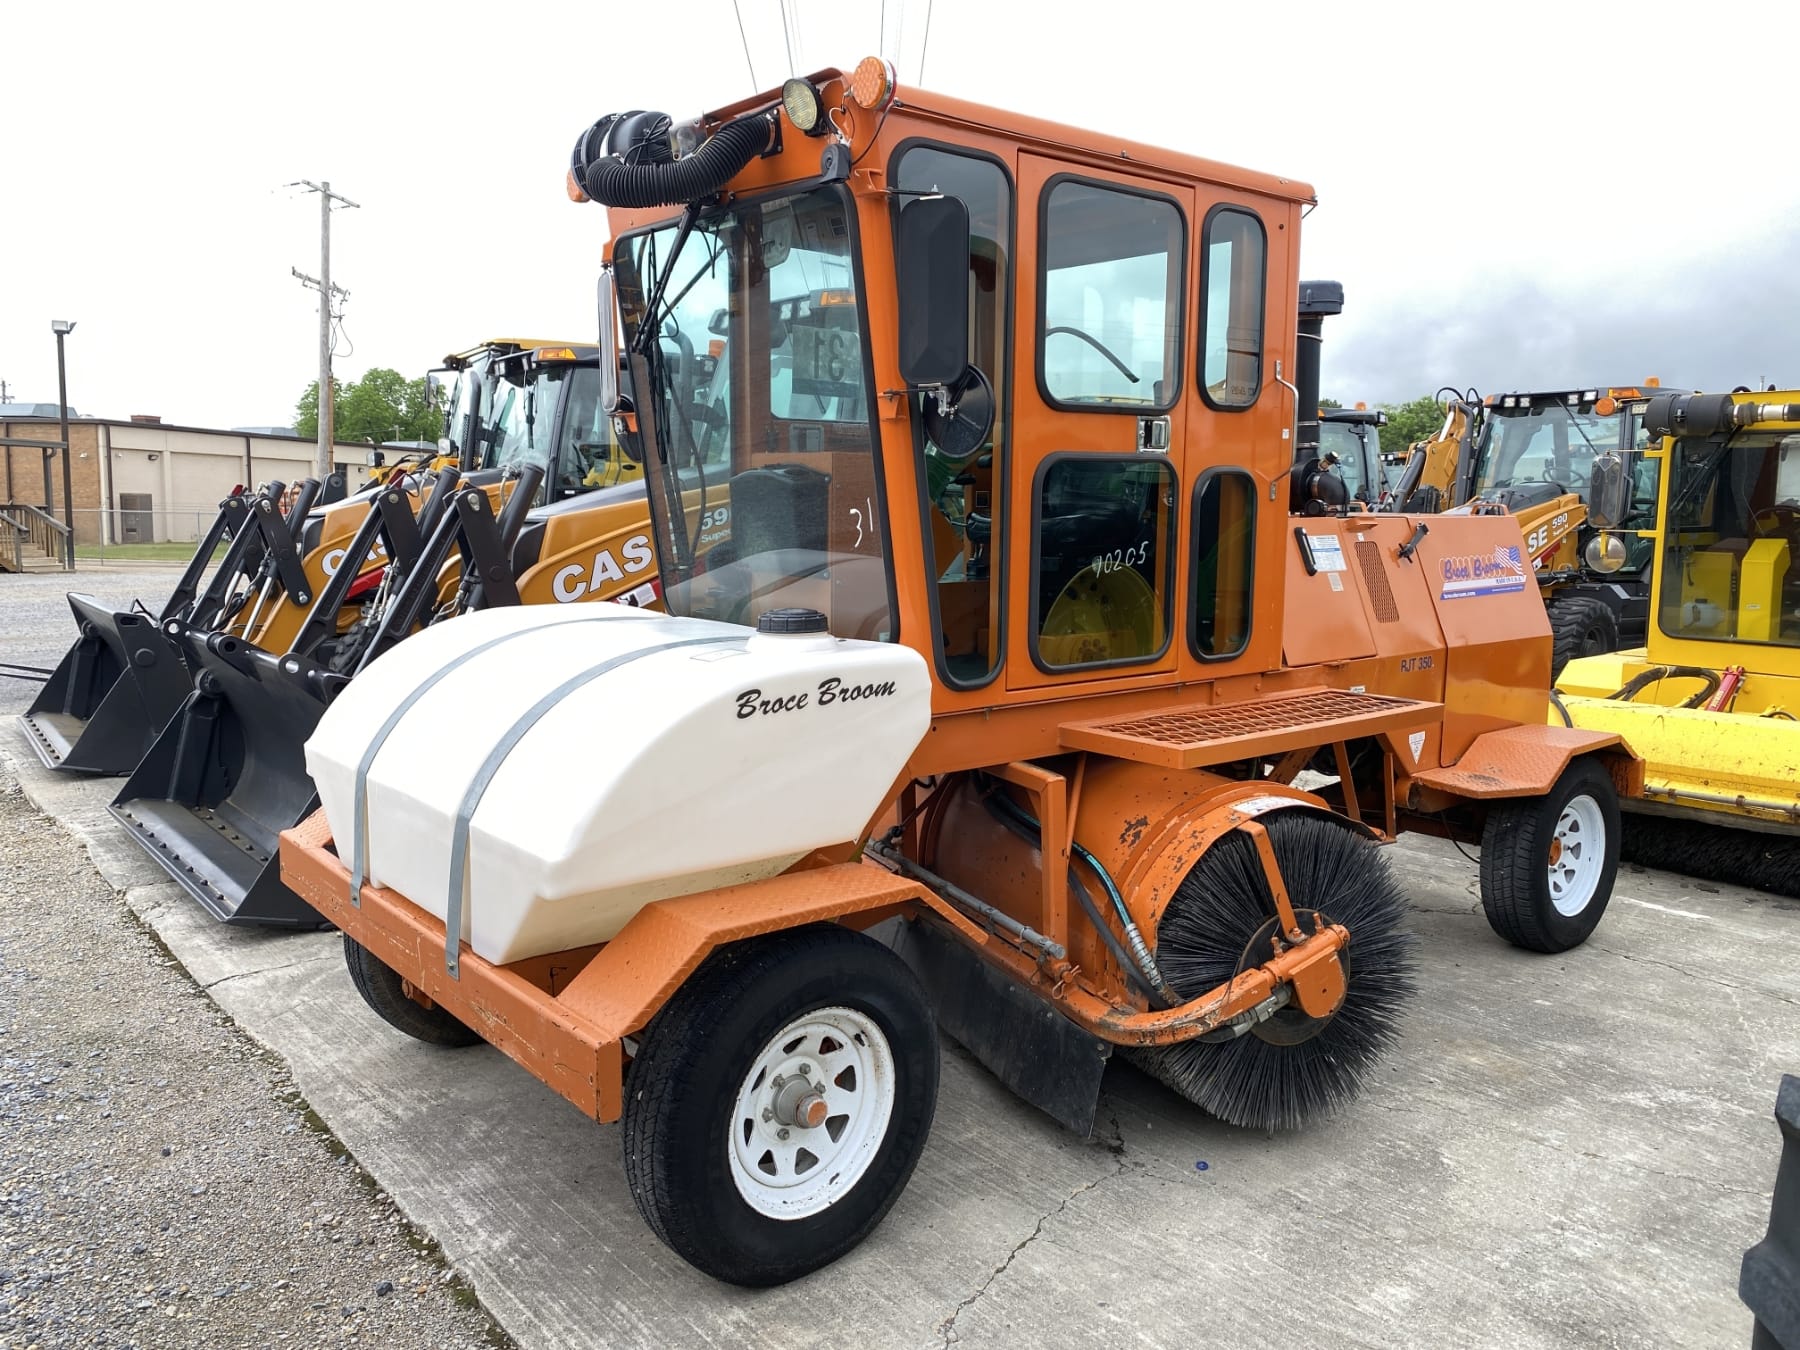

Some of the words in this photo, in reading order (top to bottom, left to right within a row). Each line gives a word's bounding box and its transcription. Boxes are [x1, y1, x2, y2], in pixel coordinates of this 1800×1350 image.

[701, 507, 731, 531] 59
[849, 496, 874, 548] 31
[1552, 512, 1568, 529] 590
[1527, 525, 1548, 553] SE
[553, 530, 662, 603] CAS
[1400, 657, 1416, 672] RJT
[1418, 655, 1432, 670] 350
[735, 688, 809, 719] Broce
[817, 677, 897, 706] Broom
